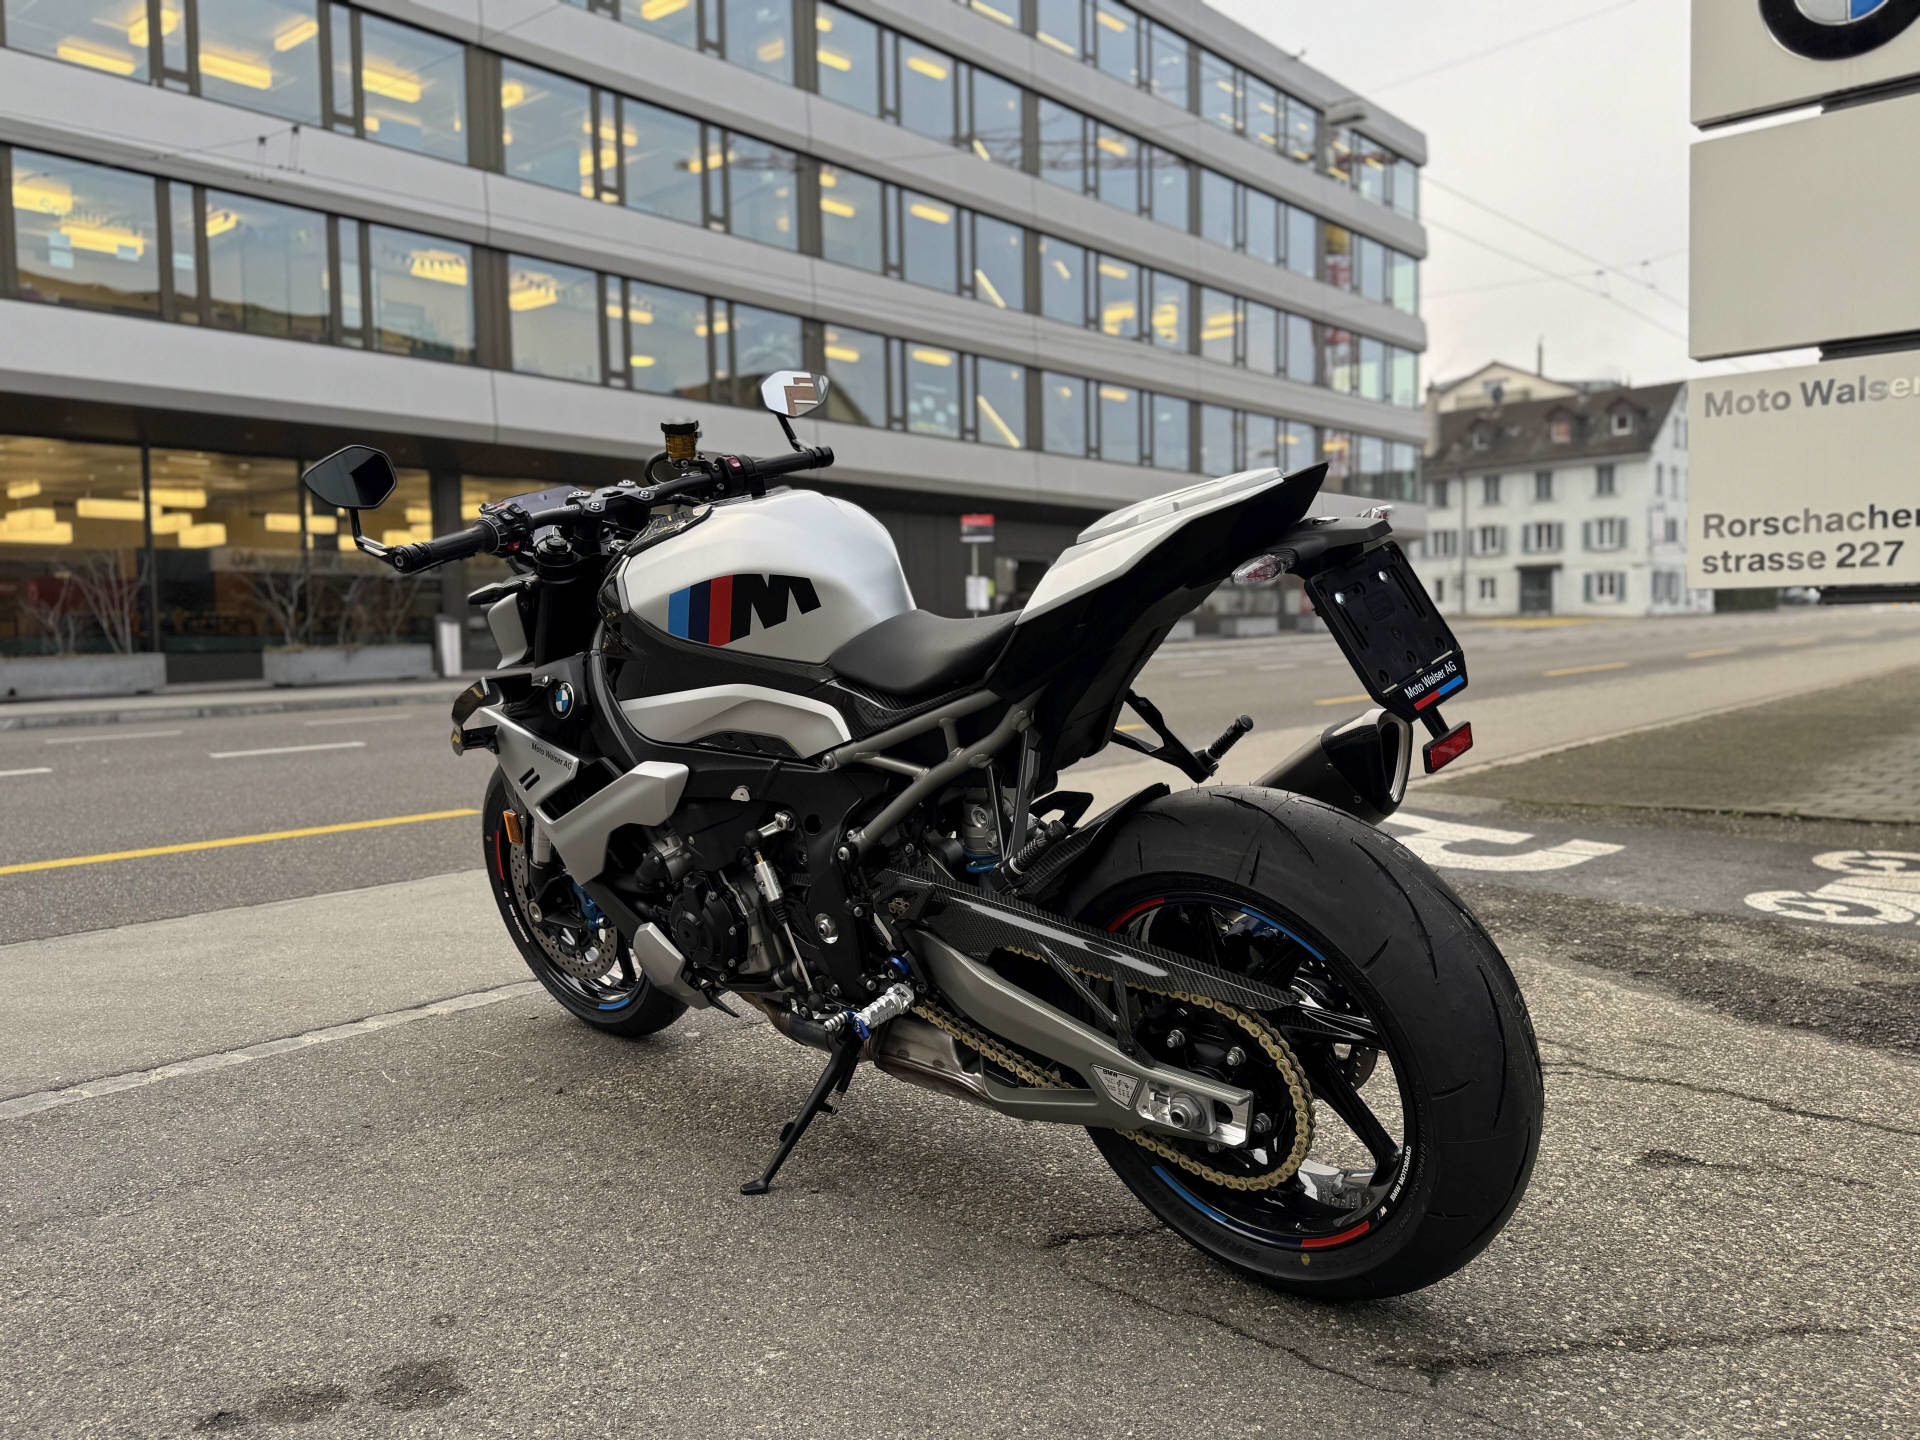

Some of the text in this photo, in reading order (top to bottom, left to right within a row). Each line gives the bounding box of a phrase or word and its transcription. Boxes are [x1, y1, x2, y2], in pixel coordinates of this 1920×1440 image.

[1704, 389, 1791, 418] Moto
[1702, 540, 1904, 575] strasse 227
[1404, 661, 1457, 699] Moto Walser AG
[563, 760, 572, 771] AG
[1390, 1145, 1411, 1202] BMW MOTORRAD
